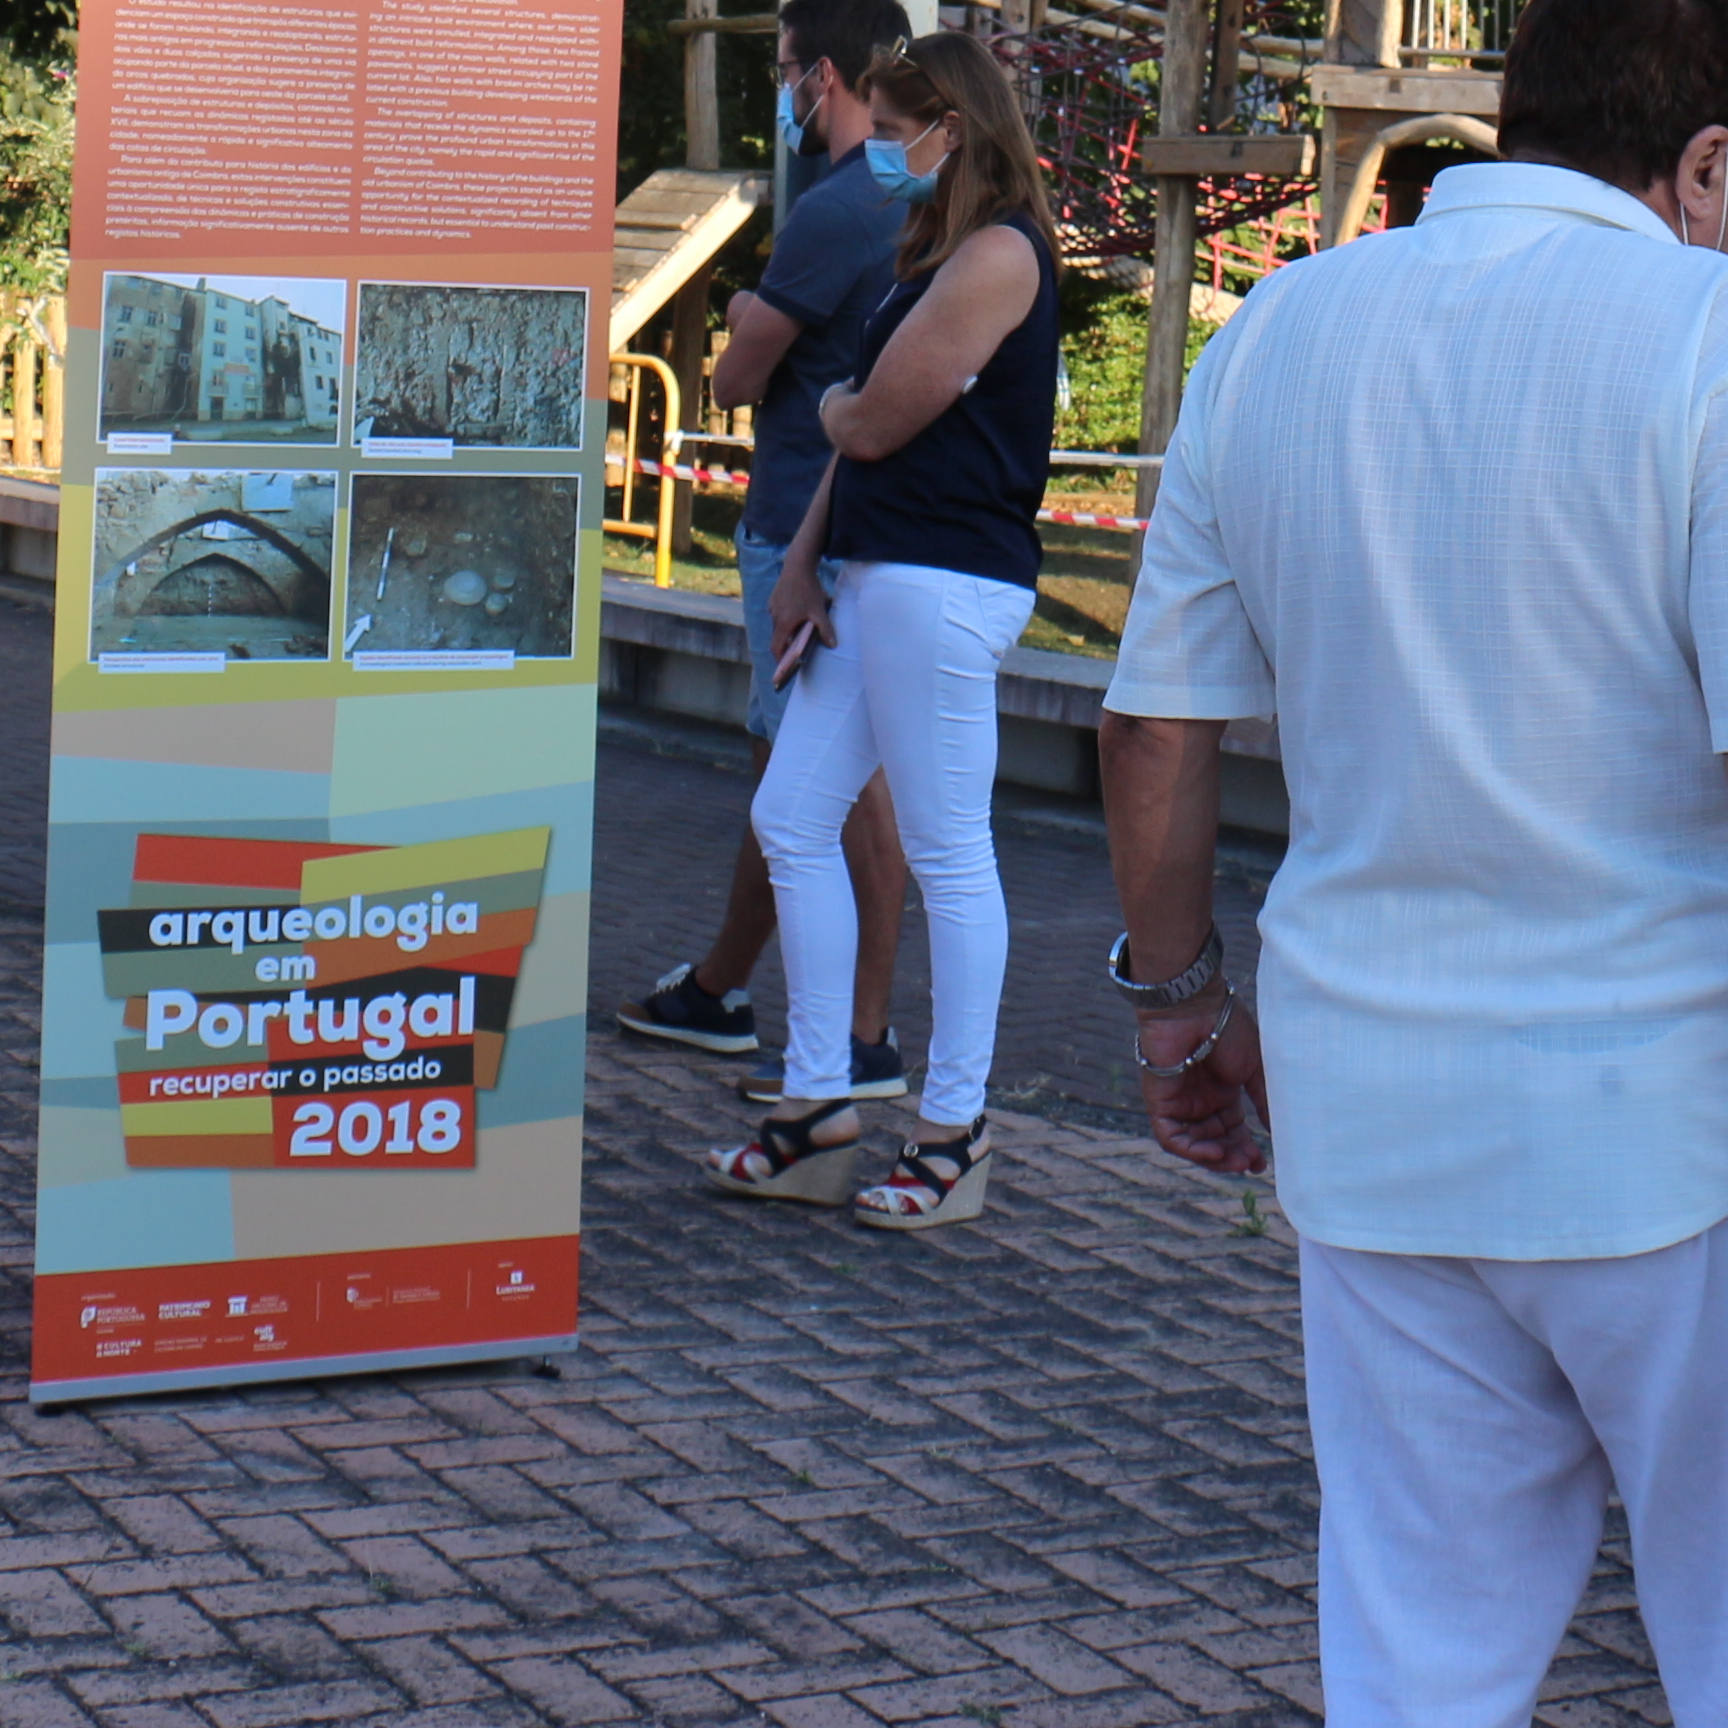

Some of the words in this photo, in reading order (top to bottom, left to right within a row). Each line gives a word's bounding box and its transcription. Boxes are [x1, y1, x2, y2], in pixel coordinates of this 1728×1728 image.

[148, 893, 479, 954] arqueologia
[255, 955, 315, 982] em
[145, 977, 475, 1060] Portugal
[149, 1067, 293, 1098] recuperar
[299, 1065, 315, 1088] o
[324, 1057, 442, 1091] passado
[289, 1099, 462, 1157] 2018
